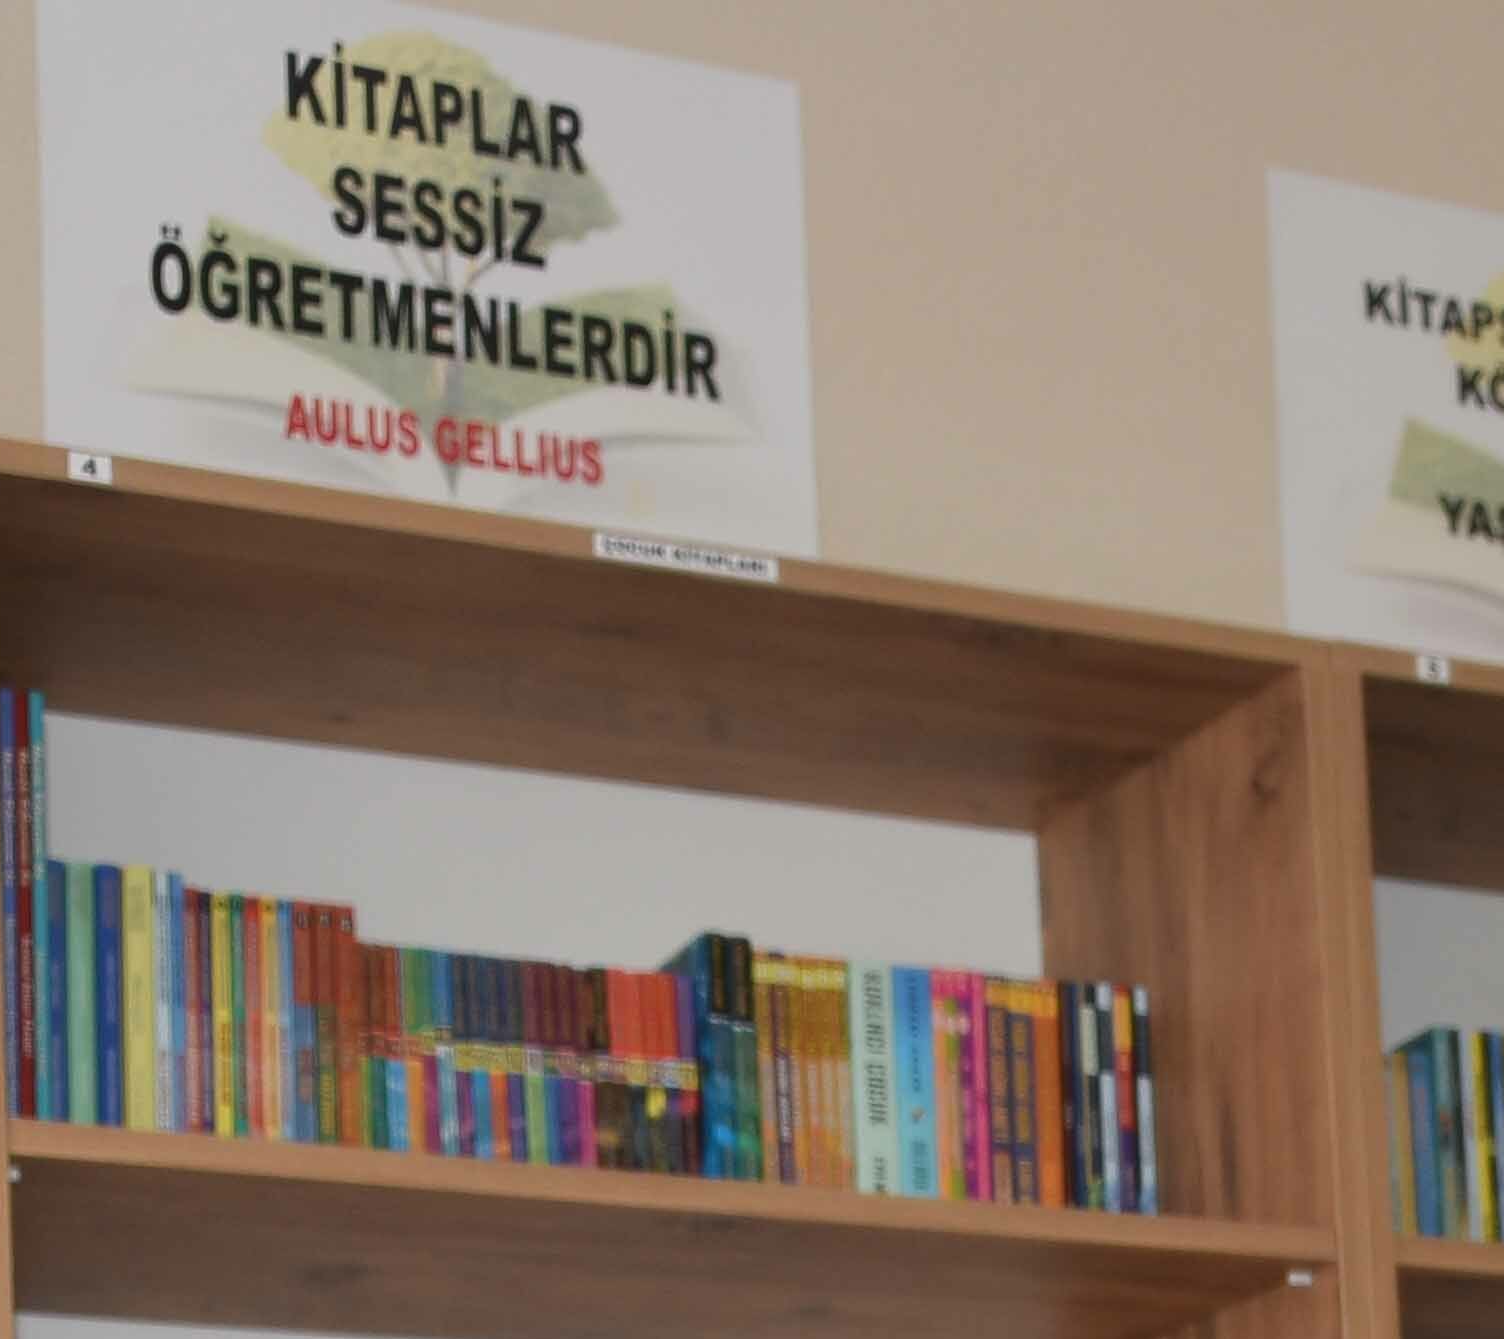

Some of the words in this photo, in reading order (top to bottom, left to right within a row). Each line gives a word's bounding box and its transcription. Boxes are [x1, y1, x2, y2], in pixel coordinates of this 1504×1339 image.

[284, 41, 587, 174] KİTAPLAR
[331, 167, 547, 269] SESSİZ
[149, 224, 720, 401] ÖĞRETMENLERDİR
[284, 394, 421, 456] AULUS
[434, 416, 604, 487] GELLIUS
